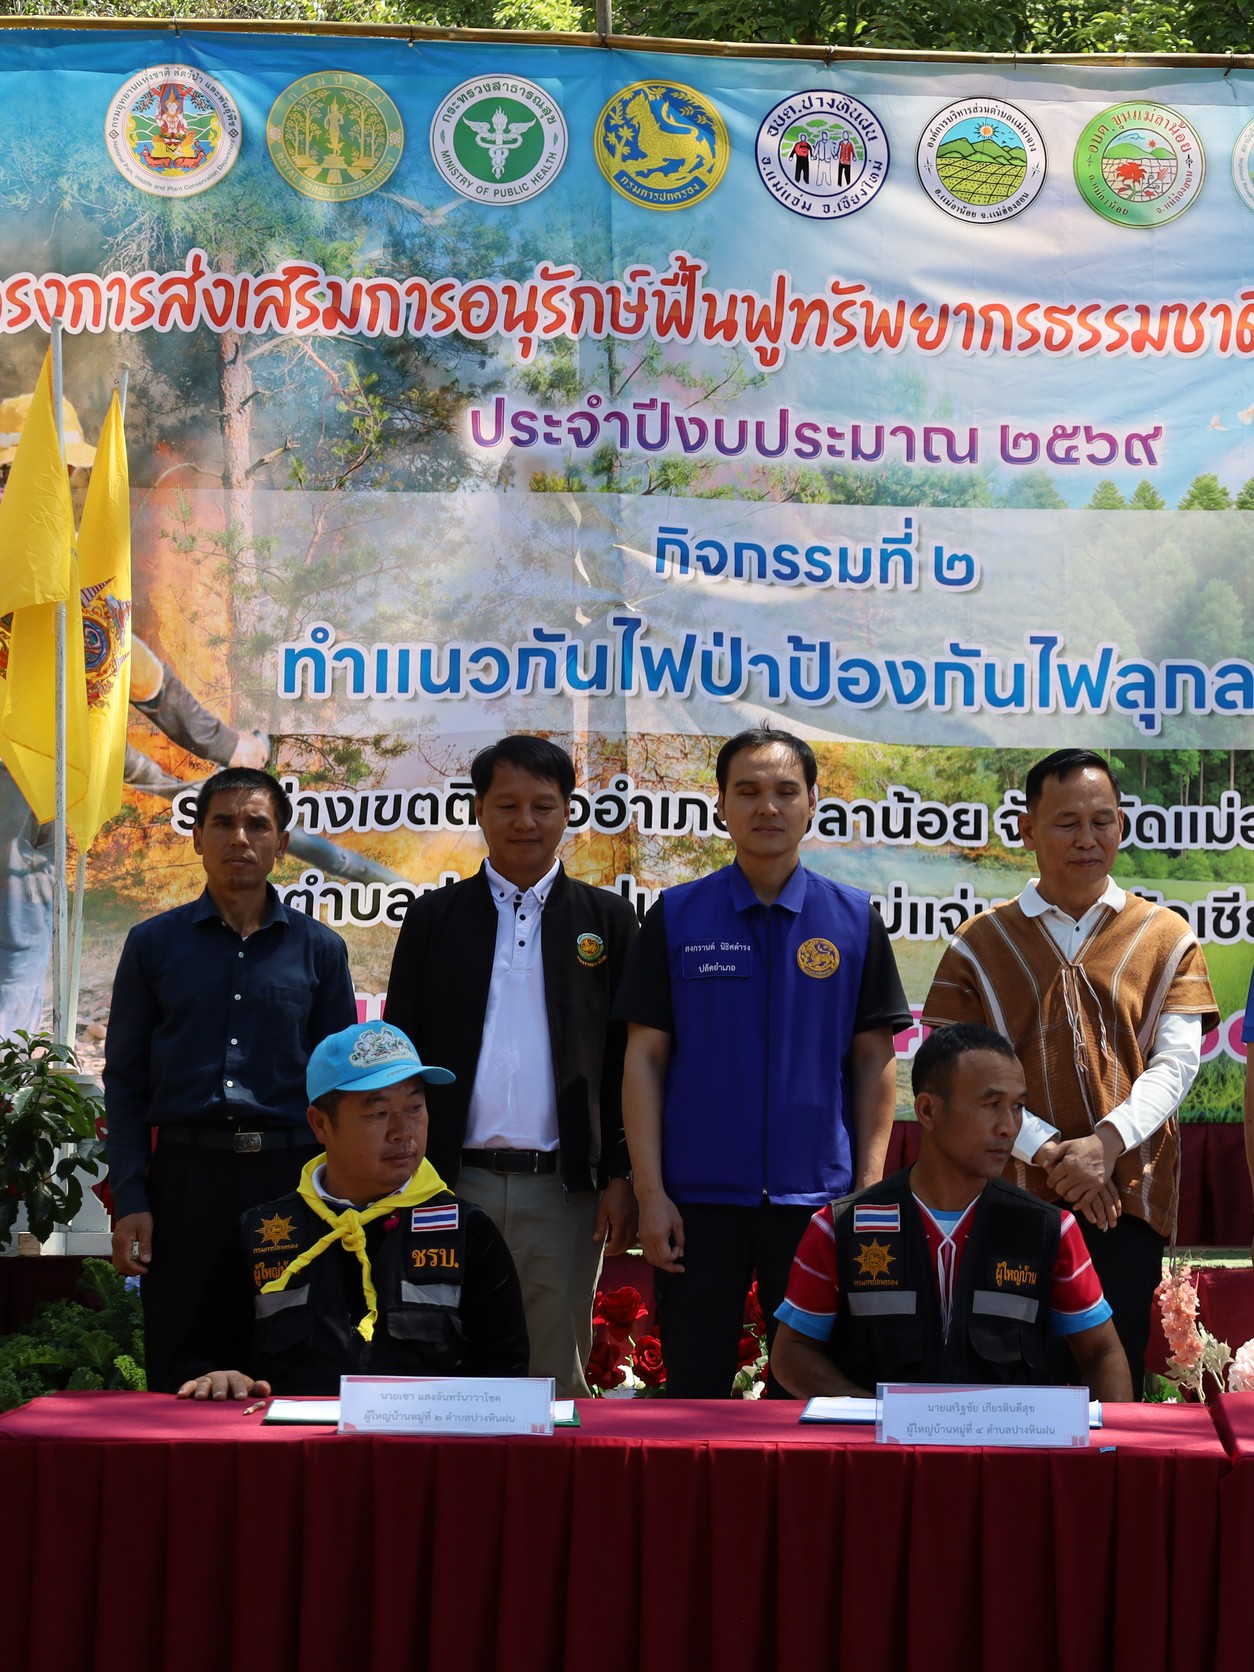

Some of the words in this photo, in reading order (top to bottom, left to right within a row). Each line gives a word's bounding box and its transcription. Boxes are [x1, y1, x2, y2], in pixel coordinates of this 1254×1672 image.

[173, 67, 204, 84] สัตว์ป่า
[442, 80, 557, 125] กระทรวงสาธารณสุข
[766, 95, 879, 142] อบต.ปางหินฝน
[112, 140, 125, 164] National
[135, 174, 153, 188] Wildlife
[183, 169, 220, 192] Conservation
[217, 139, 236, 171] Department
[276, 152, 300, 183] ROYAL
[299, 178, 337, 197] FOREST
[340, 155, 396, 197] DEPARTMENT
[440, 149, 475, 189] MINISTRY
[475, 185, 490, 196] OF
[493, 182, 530, 198] PUBLIC
[531, 151, 558, 186] HEALTH
[761, 156, 813, 212] อ.แม่แจ่ม
[822, 158, 884, 214] จ.เชียงใหม่
[620, 175, 701, 202] กรมการปกครอง
[934, 188, 977, 218] อ.แม่ลาน้อย
[470, 394, 979, 464] ประจำปีงบประมาณ
[1000, 422, 1163, 466] ๒๕๖๙
[655, 516, 913, 585] กิจกรรมที่
[934, 545, 975, 585] ๒
[411, 1248, 460, 1268] ชรบ.
[995, 1261, 1037, 1287] ผู้ใหญ่บ้าน
[364, 1409, 432, 1424] ผู้ใหญ่บ้านหมู่ที่
[445, 1411, 516, 1423] ตำบลปางหินฝน
[906, 1422, 973, 1437] ผู้ใหญ่บ้านหมู่ที่
[986, 1424, 1056, 1436] ตำบลปางหินฝน
